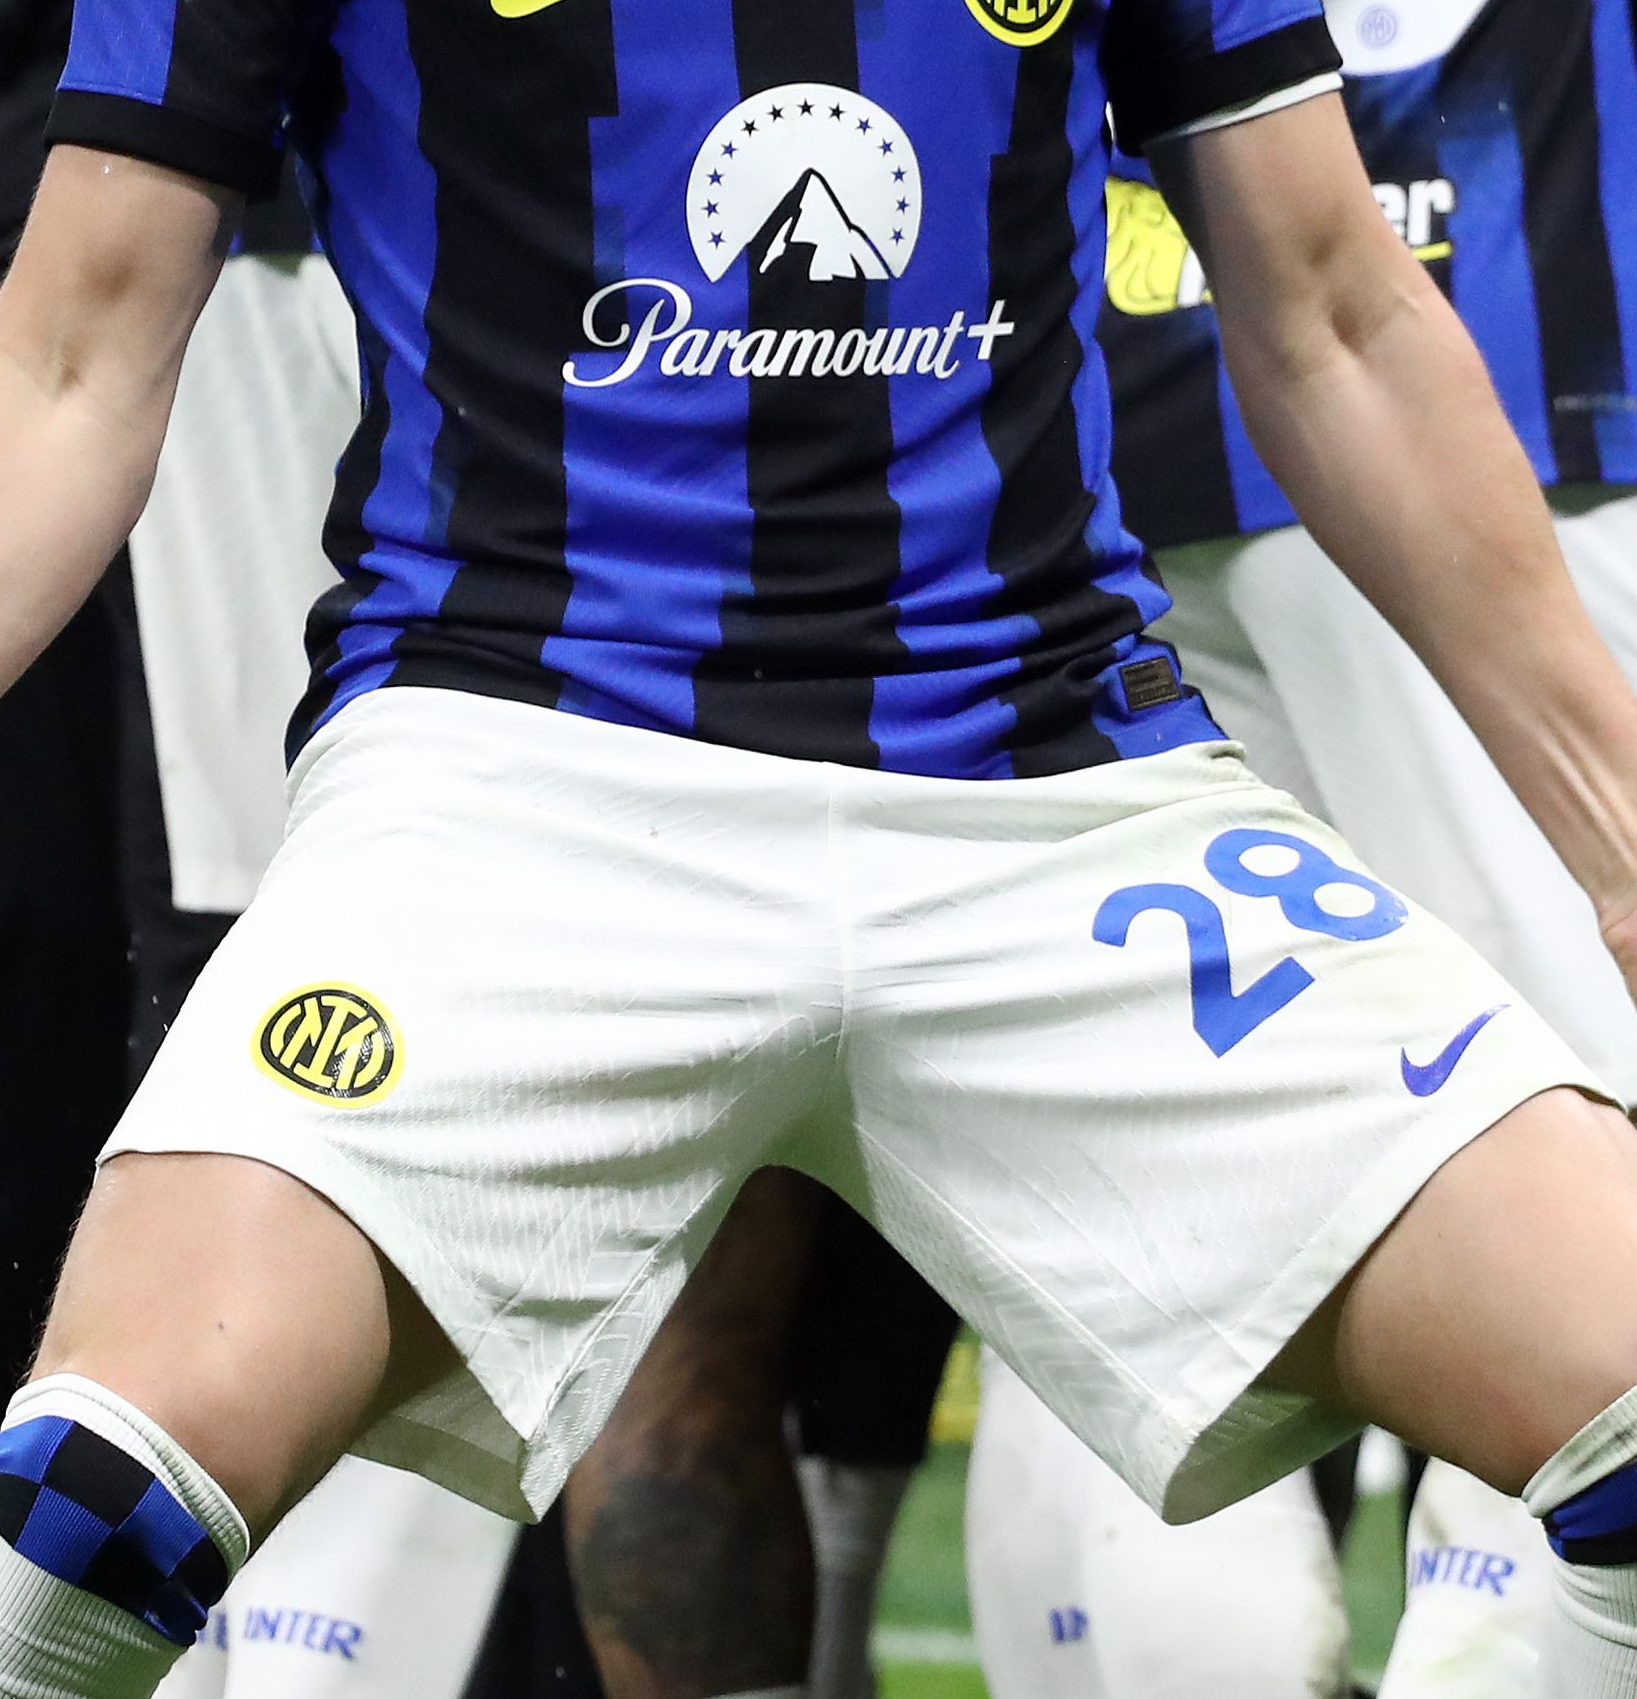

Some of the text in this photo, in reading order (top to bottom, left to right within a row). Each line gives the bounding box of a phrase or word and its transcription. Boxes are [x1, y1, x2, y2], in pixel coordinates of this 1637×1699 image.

[562, 277, 1016, 388] Paramount+
[1092, 828, 1409, 1059] 28
[243, 1606, 364, 1661] INTER
